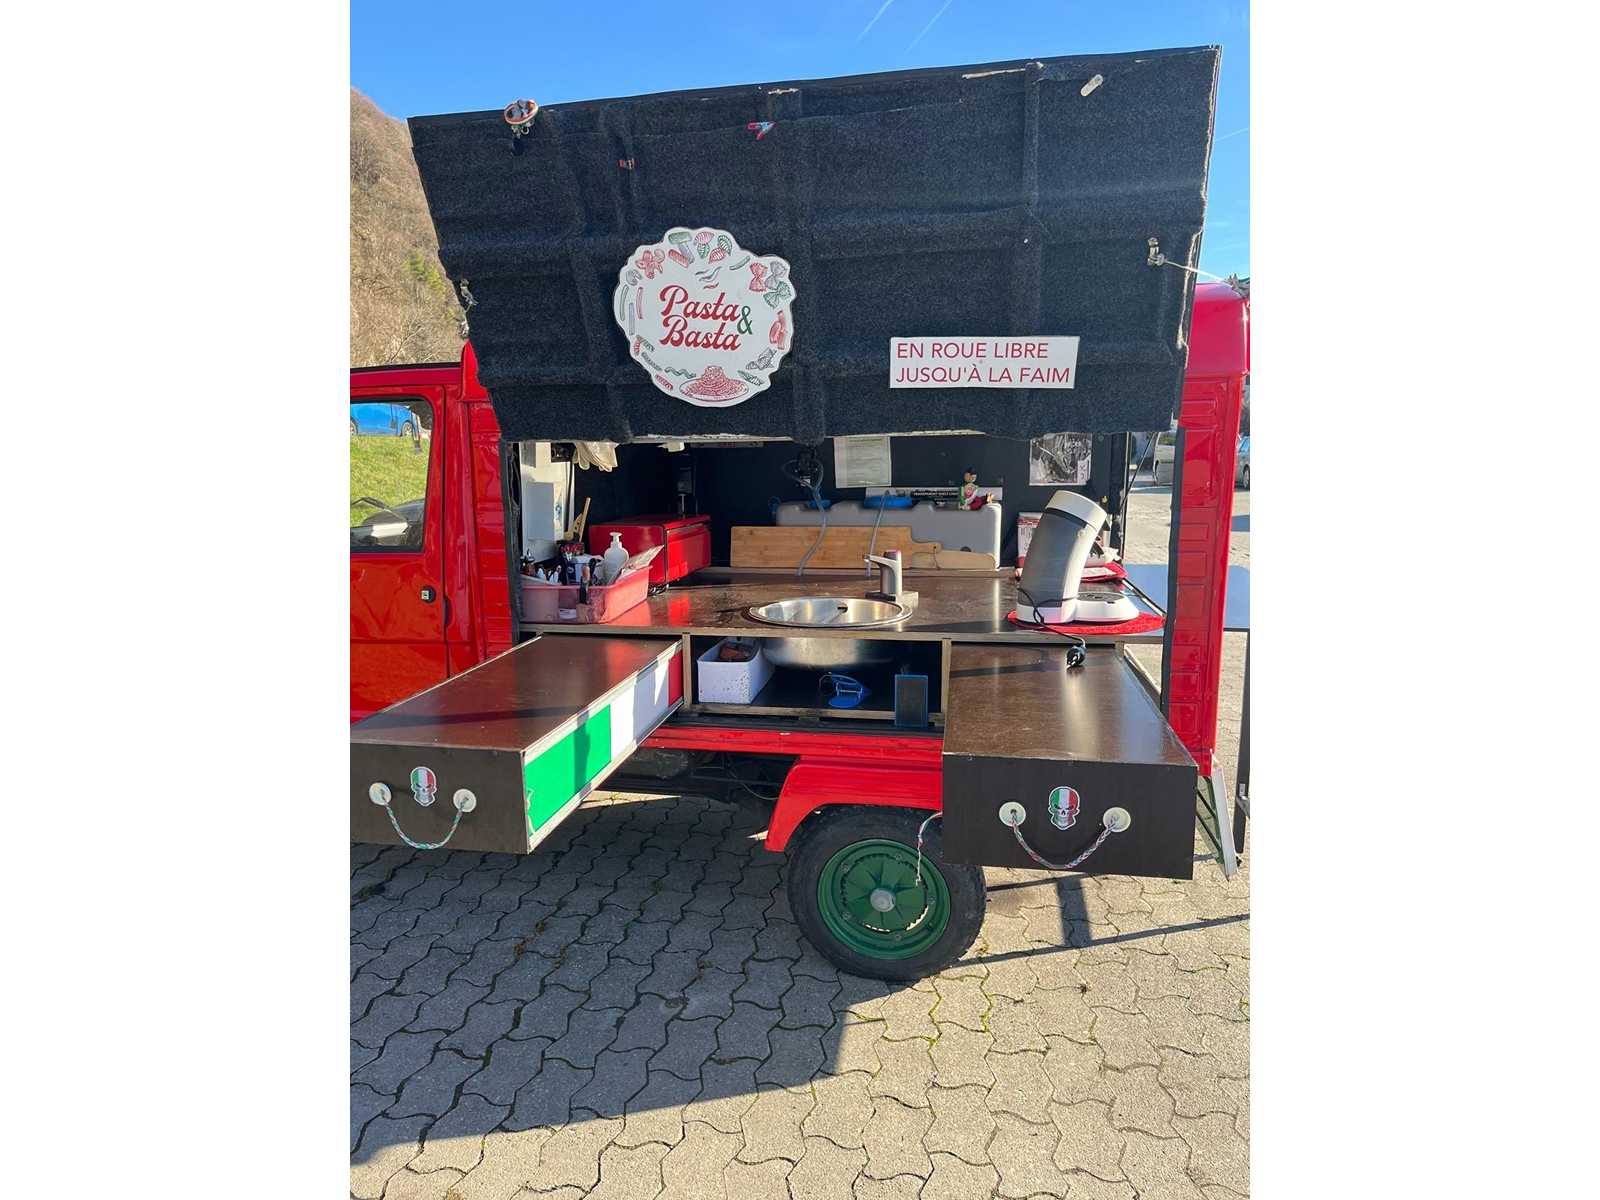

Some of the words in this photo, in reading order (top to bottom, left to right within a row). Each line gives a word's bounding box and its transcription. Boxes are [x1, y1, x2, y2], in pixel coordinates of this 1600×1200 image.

[659, 284, 742, 321] Pasta
[737, 305, 753, 335] &
[659, 314, 742, 351] Basta
[896, 342, 924, 359] EN
[931, 342, 987, 359] ROUE
[994, 342, 1049, 359] LIBRE
[896, 363, 982, 383] JUSQU'À
[988, 367, 1013, 383] LA
[1019, 367, 1070, 383] FAIM
